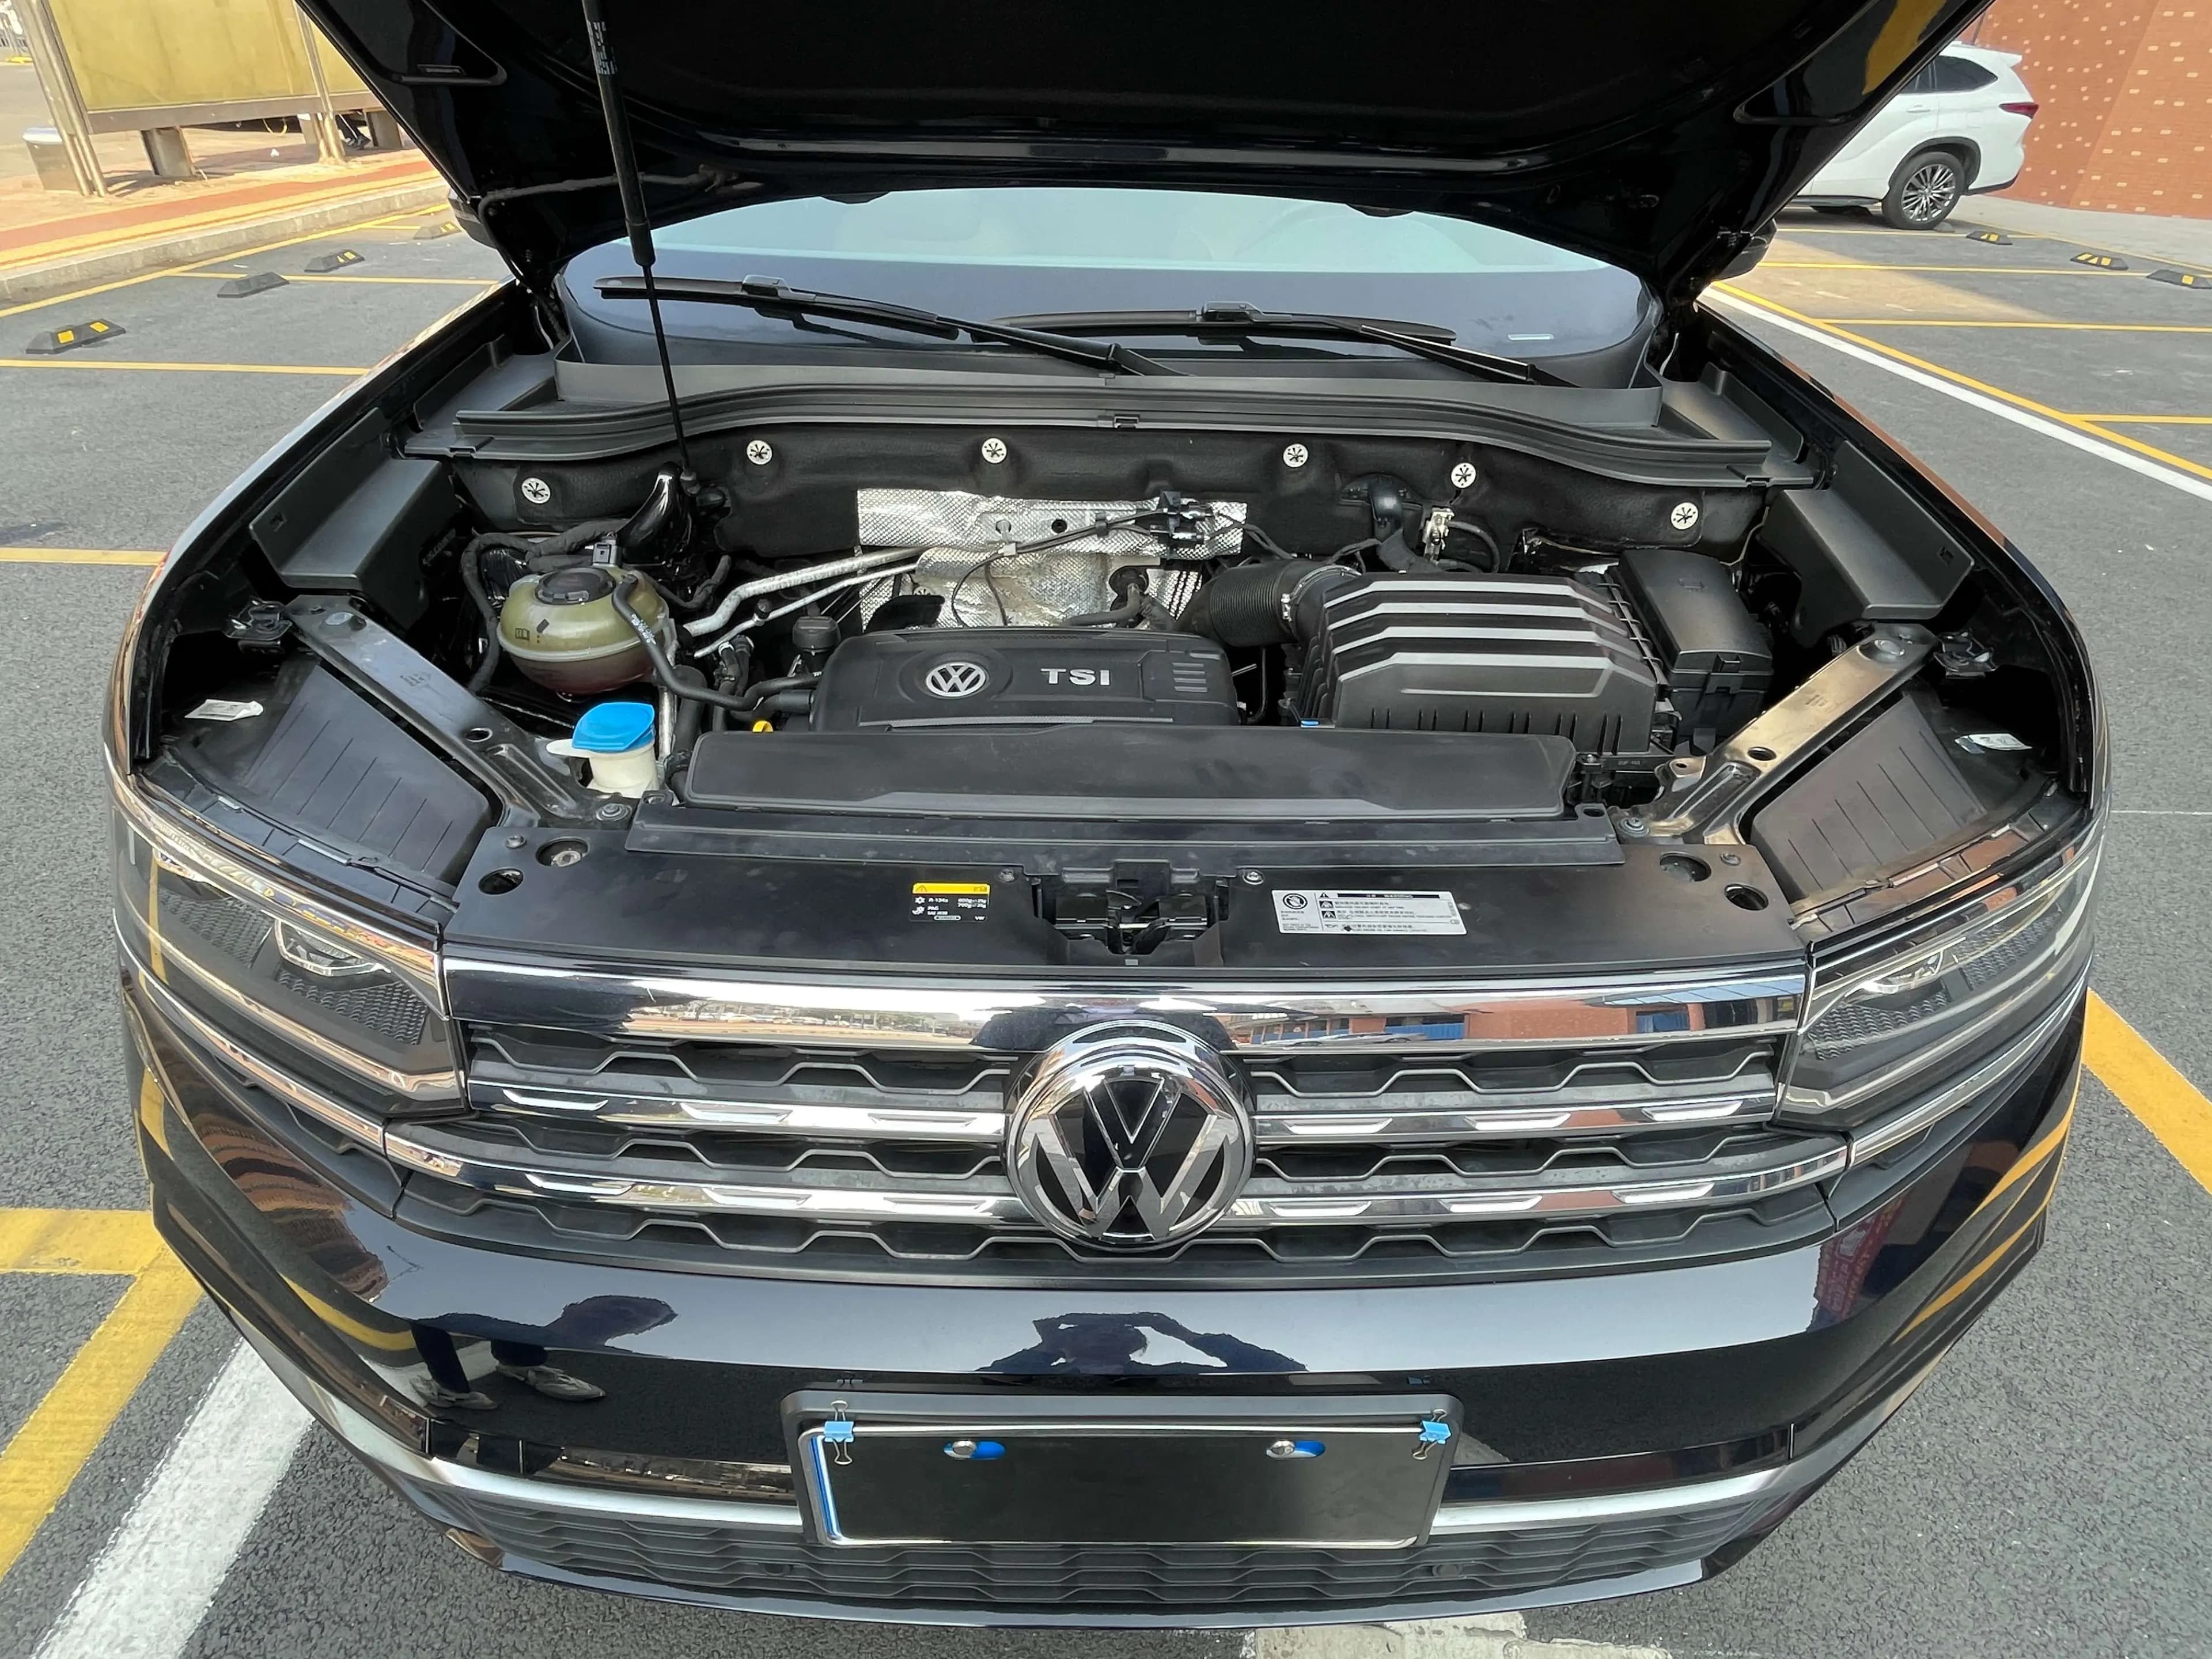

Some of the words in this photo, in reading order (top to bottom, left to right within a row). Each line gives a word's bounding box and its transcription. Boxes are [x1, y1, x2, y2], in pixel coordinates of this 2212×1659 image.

[926, 662, 986, 697] VW
[1040, 668, 1109, 685] TSI
[1016, 1055, 1242, 1244] VW
